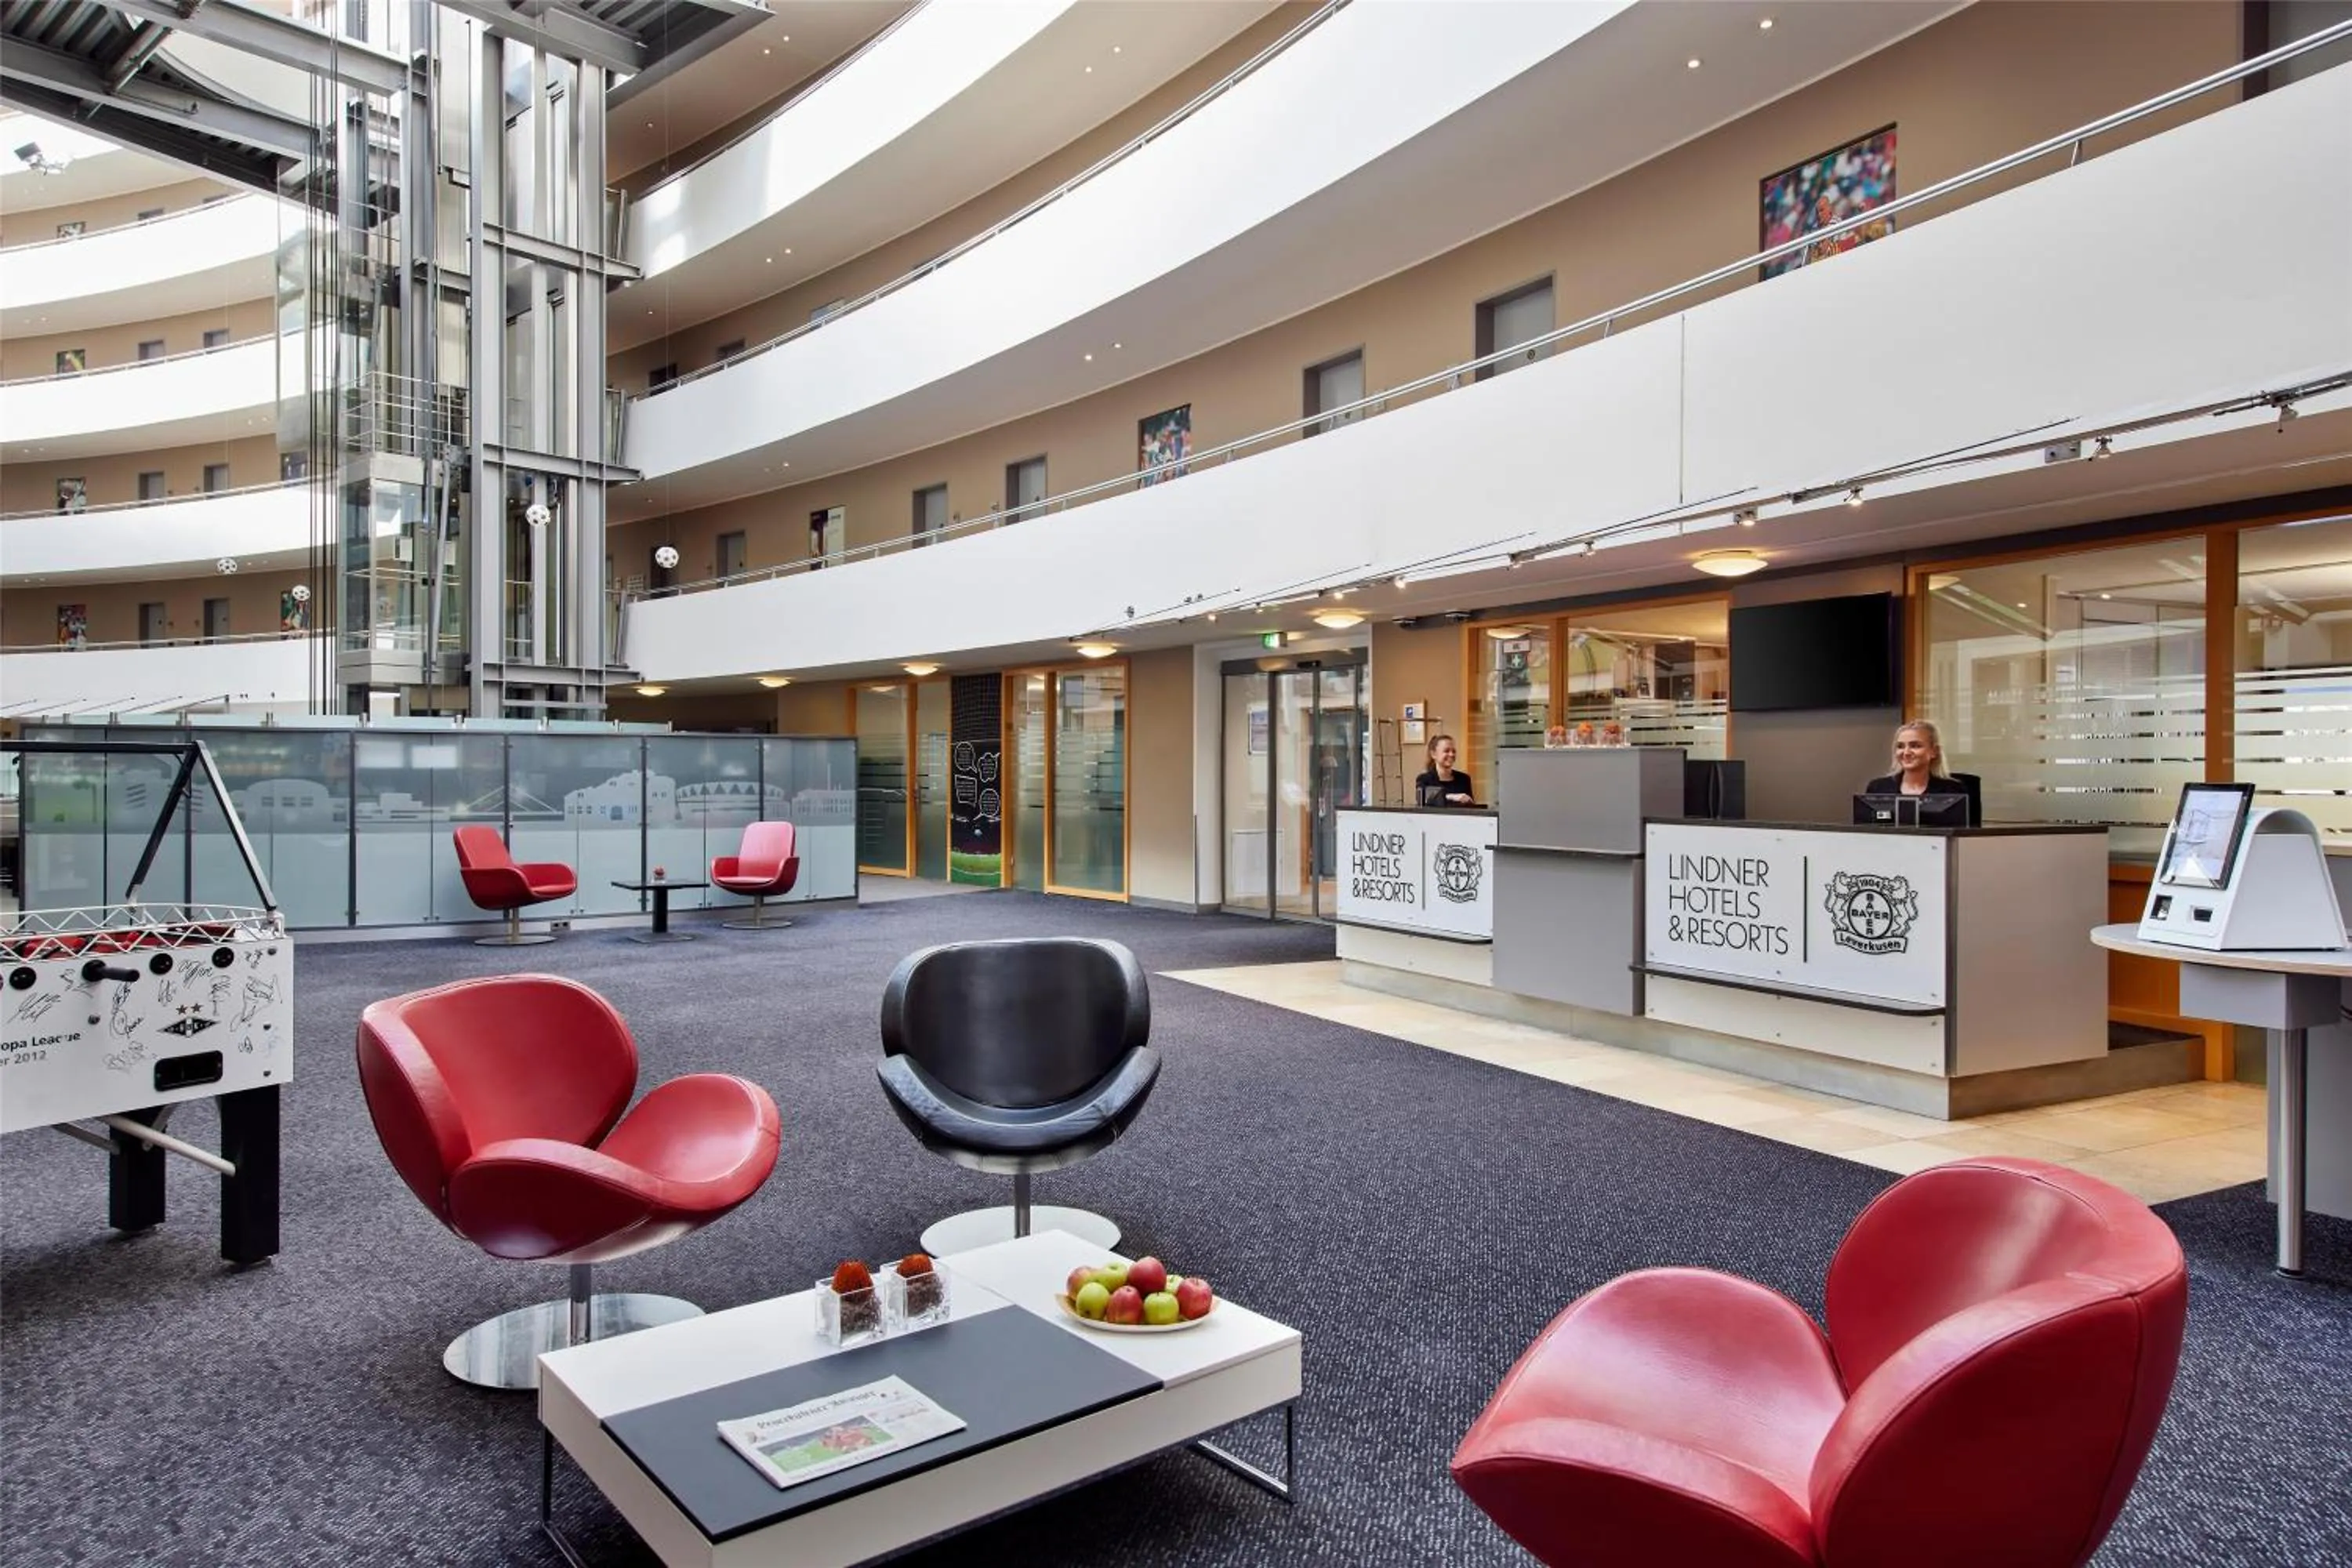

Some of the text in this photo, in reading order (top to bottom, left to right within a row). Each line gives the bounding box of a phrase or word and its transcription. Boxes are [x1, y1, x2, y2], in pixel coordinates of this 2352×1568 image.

[1352, 831, 1406, 855] LINDNER
[1352, 855, 1401, 879] HOTELS
[1668, 853, 1769, 887] LINDNER
[1859, 879, 1881, 888] 1904
[1668, 884, 1761, 920] HOTELS
[1865, 893, 1875, 935] BAYER
[1851, 909, 1889, 920] BAYER
[1839, 932, 1902, 951] Leverkusen
[14, 1050, 47, 1065] 2012
